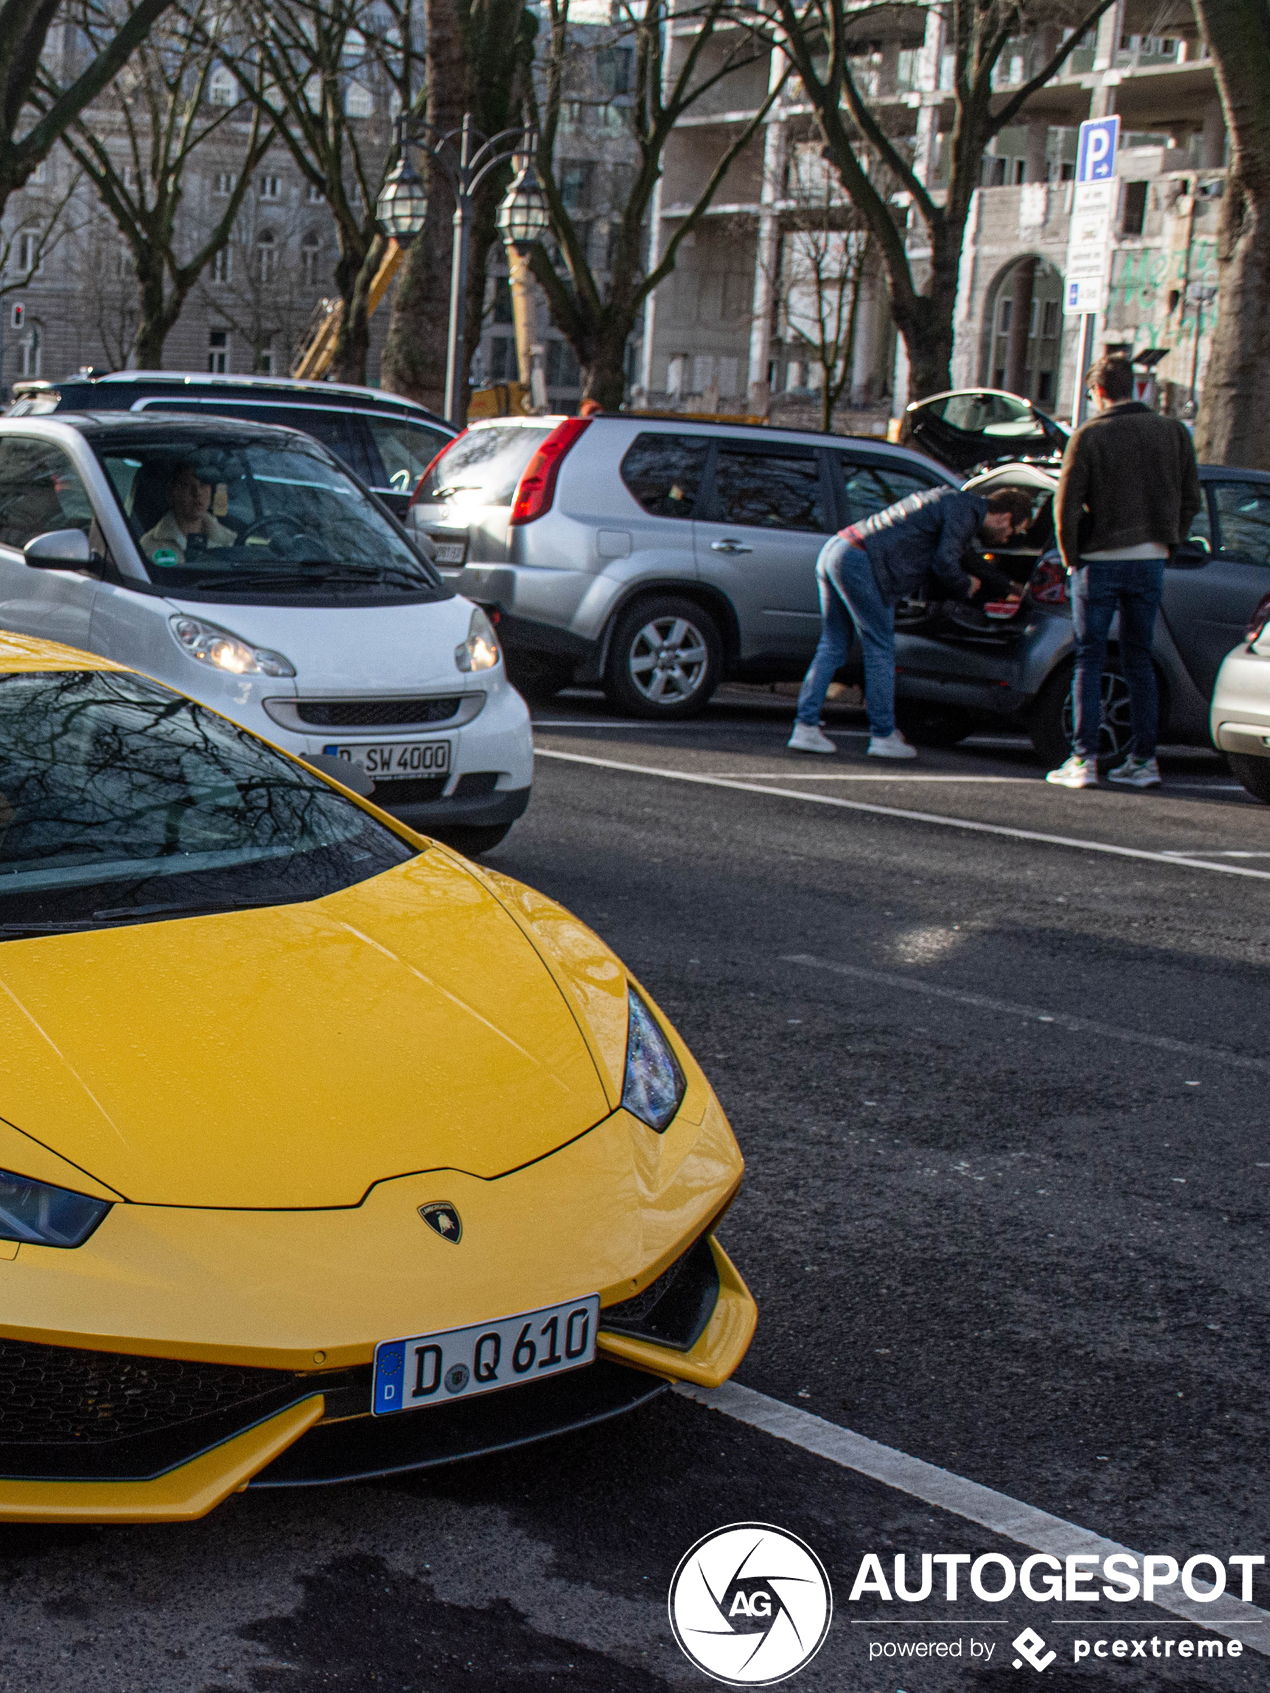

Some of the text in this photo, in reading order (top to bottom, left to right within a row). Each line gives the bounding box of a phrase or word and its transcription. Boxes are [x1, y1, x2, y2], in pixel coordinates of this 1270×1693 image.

[1085, 128, 1109, 180] P
[366, 748, 392, 772] SW
[397, 745, 446, 770] 4000
[412, 1308, 589, 1398] D Q 610
[384, 1385, 395, 1400] D
